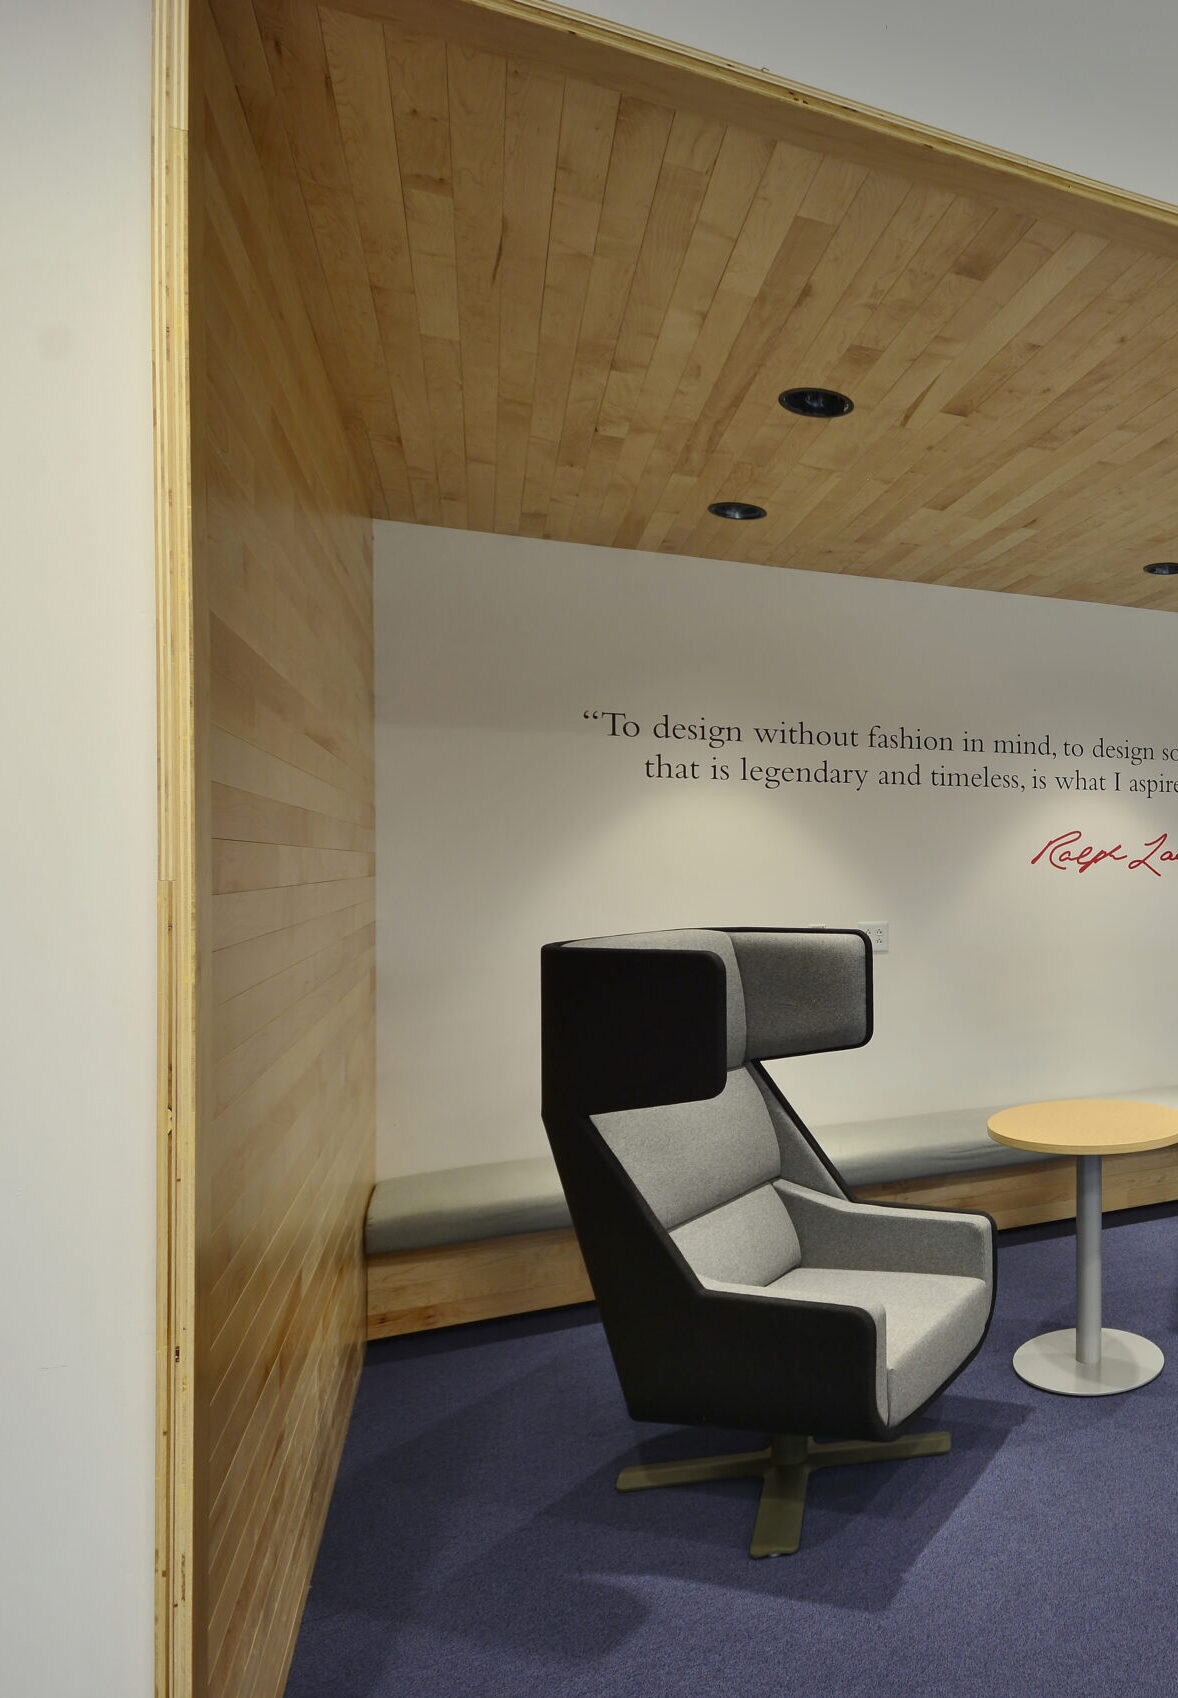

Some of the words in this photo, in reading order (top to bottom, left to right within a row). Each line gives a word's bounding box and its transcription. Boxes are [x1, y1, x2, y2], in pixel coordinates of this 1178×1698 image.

[583, 709, 641, 738] “To
[653, 714, 743, 749] design
[753, 721, 859, 748] without
[867, 725, 954, 752] fashion
[962, 731, 984, 753] in
[994, 734, 1057, 760] mind,
[1063, 740, 1084, 758] to
[1092, 737, 1155, 766] design
[644, 754, 700, 780] that
[710, 757, 730, 781] is
[740, 757, 869, 791] legendary
[878, 764, 922, 787] and
[930, 764, 1026, 792] timeless,
[1032, 769, 1047, 790] is
[1055, 769, 1107, 792] what
[1113, 772, 1121, 792] I
[1031, 830, 1128, 874] Ralph
